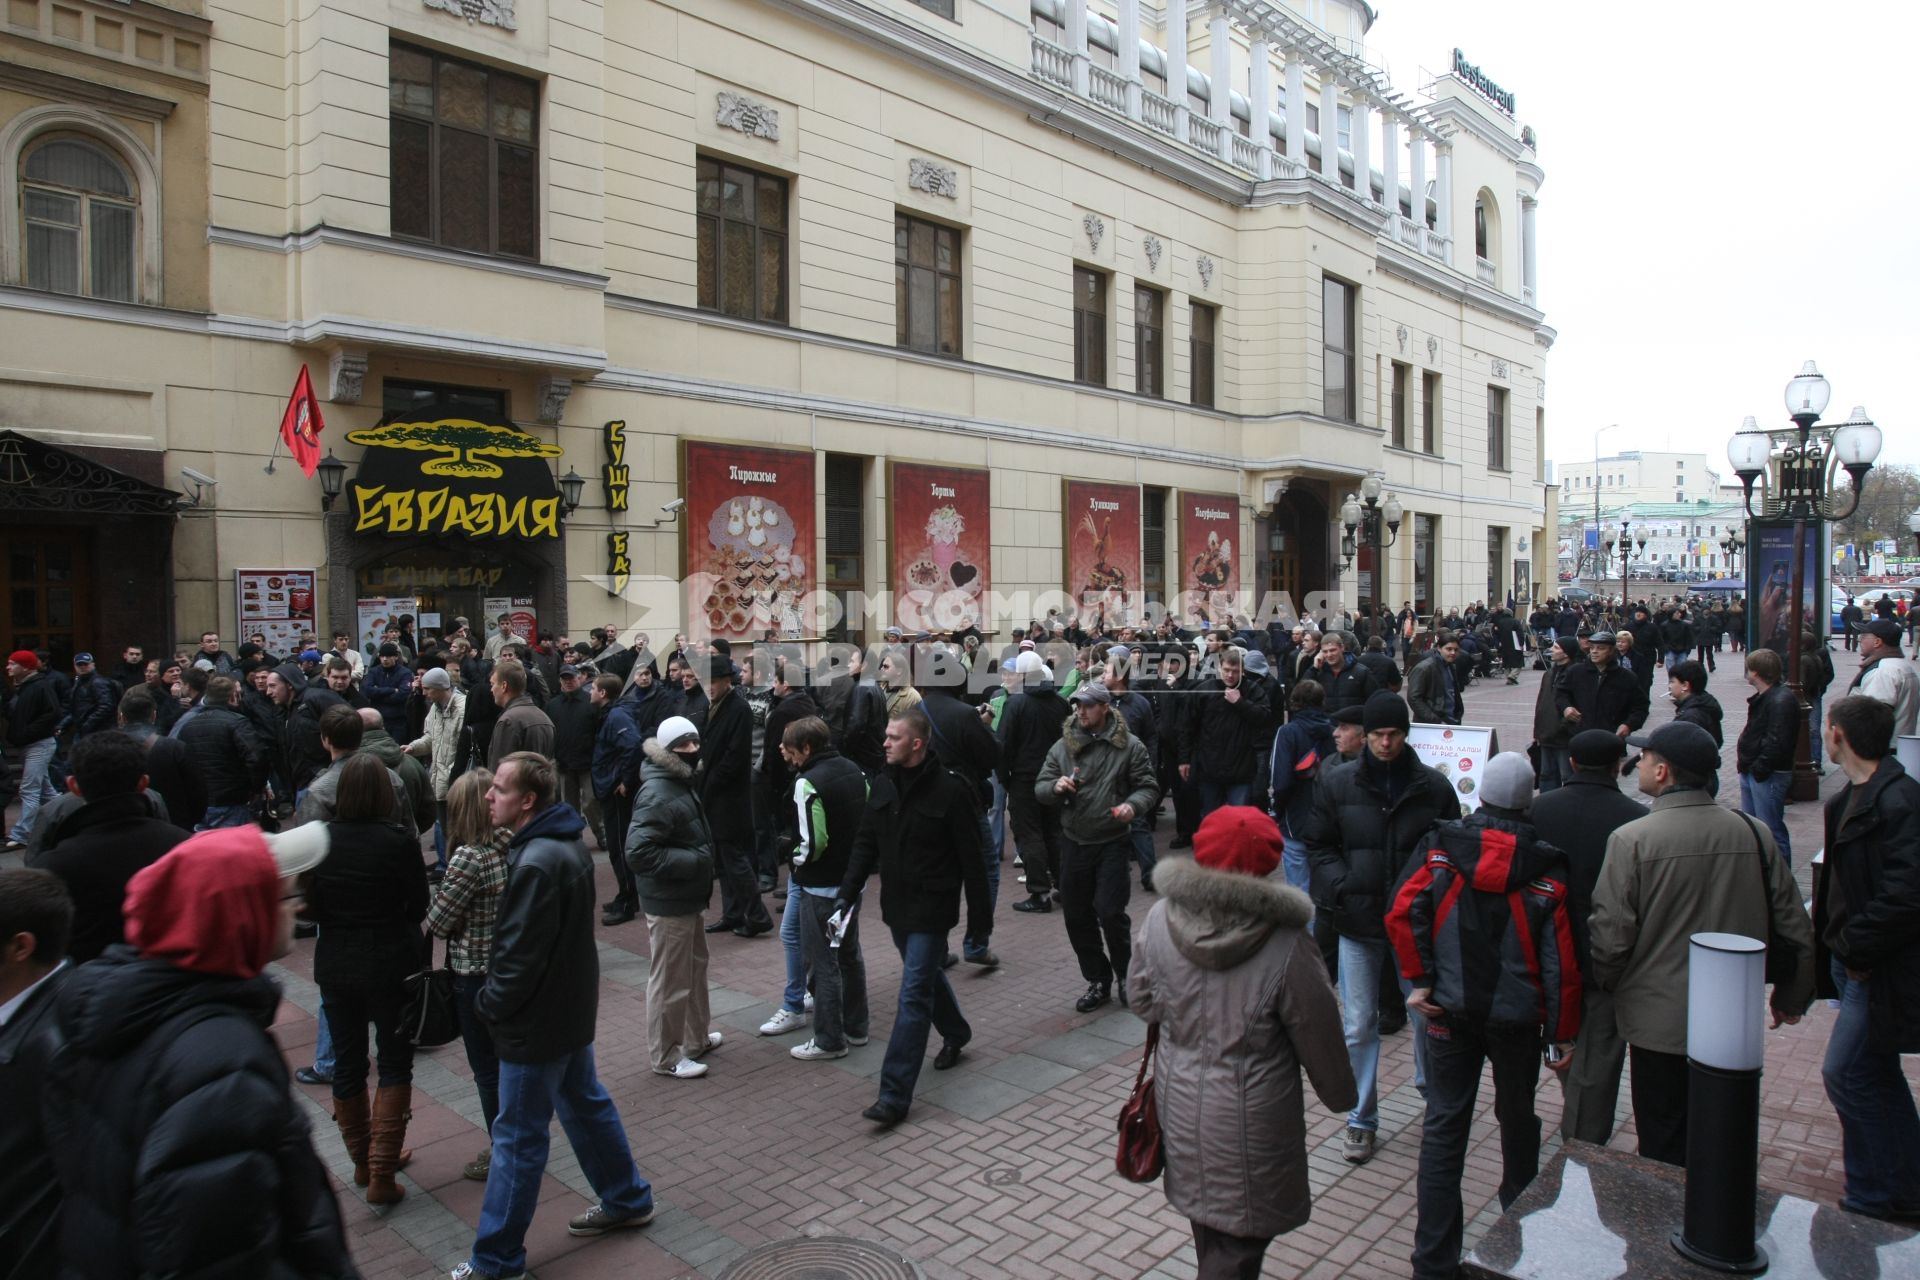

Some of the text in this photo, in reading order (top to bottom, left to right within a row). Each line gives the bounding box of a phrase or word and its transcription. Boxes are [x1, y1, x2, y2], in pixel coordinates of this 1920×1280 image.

[1453, 47, 1515, 113] Restaurant
[609, 421, 629, 509] СУШИ
[729, 465, 777, 484] Пирожные
[931, 482, 956, 499] Торты
[354, 484, 560, 538] ЕВРАЗИЯ
[1089, 497, 1120, 512] Кулинария
[613, 533, 630, 595] БАР
